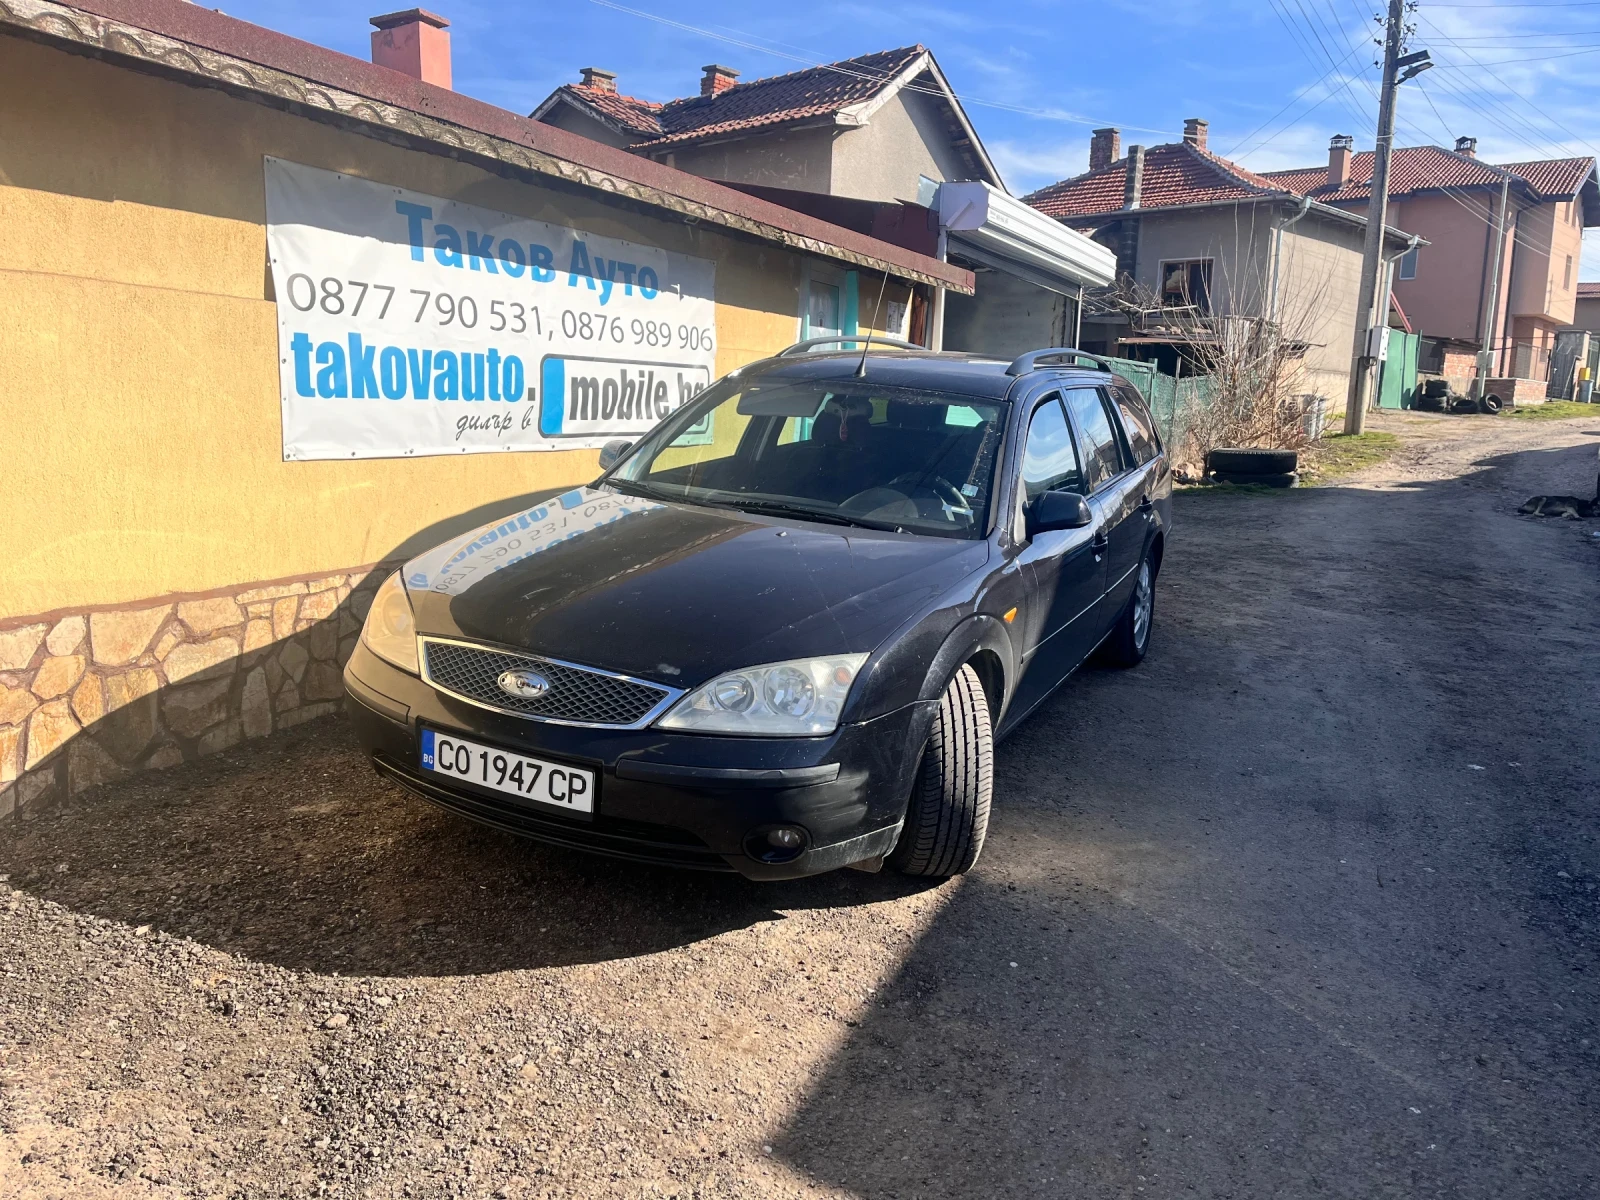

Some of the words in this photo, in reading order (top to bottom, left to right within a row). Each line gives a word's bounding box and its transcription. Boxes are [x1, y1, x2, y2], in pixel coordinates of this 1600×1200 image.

[396, 200, 556, 283] Таков
[567, 242, 659, 306] Ауто
[286, 272, 396, 320] 0877
[409, 288, 479, 329] 790
[561, 309, 625, 344] 0876
[631, 318, 672, 348] 989
[677, 324, 713, 352] 906
[423, 753, 434, 765] BG
[479, 751, 543, 794] 1947
[548, 769, 587, 804] CP
